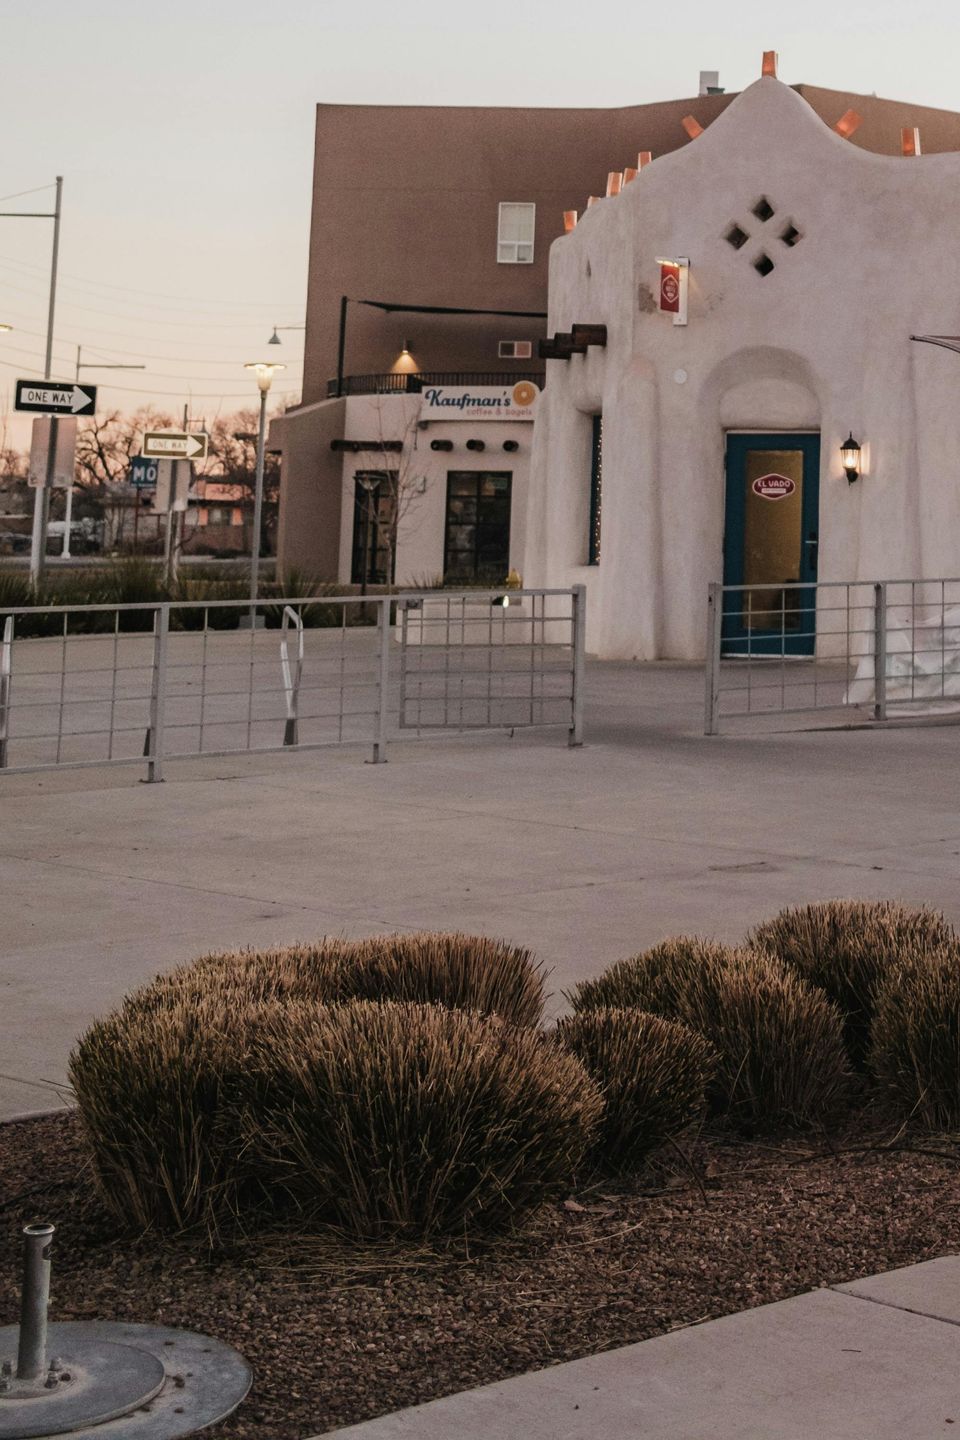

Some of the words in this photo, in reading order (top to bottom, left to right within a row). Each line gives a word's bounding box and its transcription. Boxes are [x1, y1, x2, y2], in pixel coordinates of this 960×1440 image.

[27, 390, 48, 403] ONE
[52, 392, 74, 404] WAY
[424, 389, 511, 410] Kaufman's
[152, 441, 169, 449] ONE
[171, 442, 187, 450] WAY
